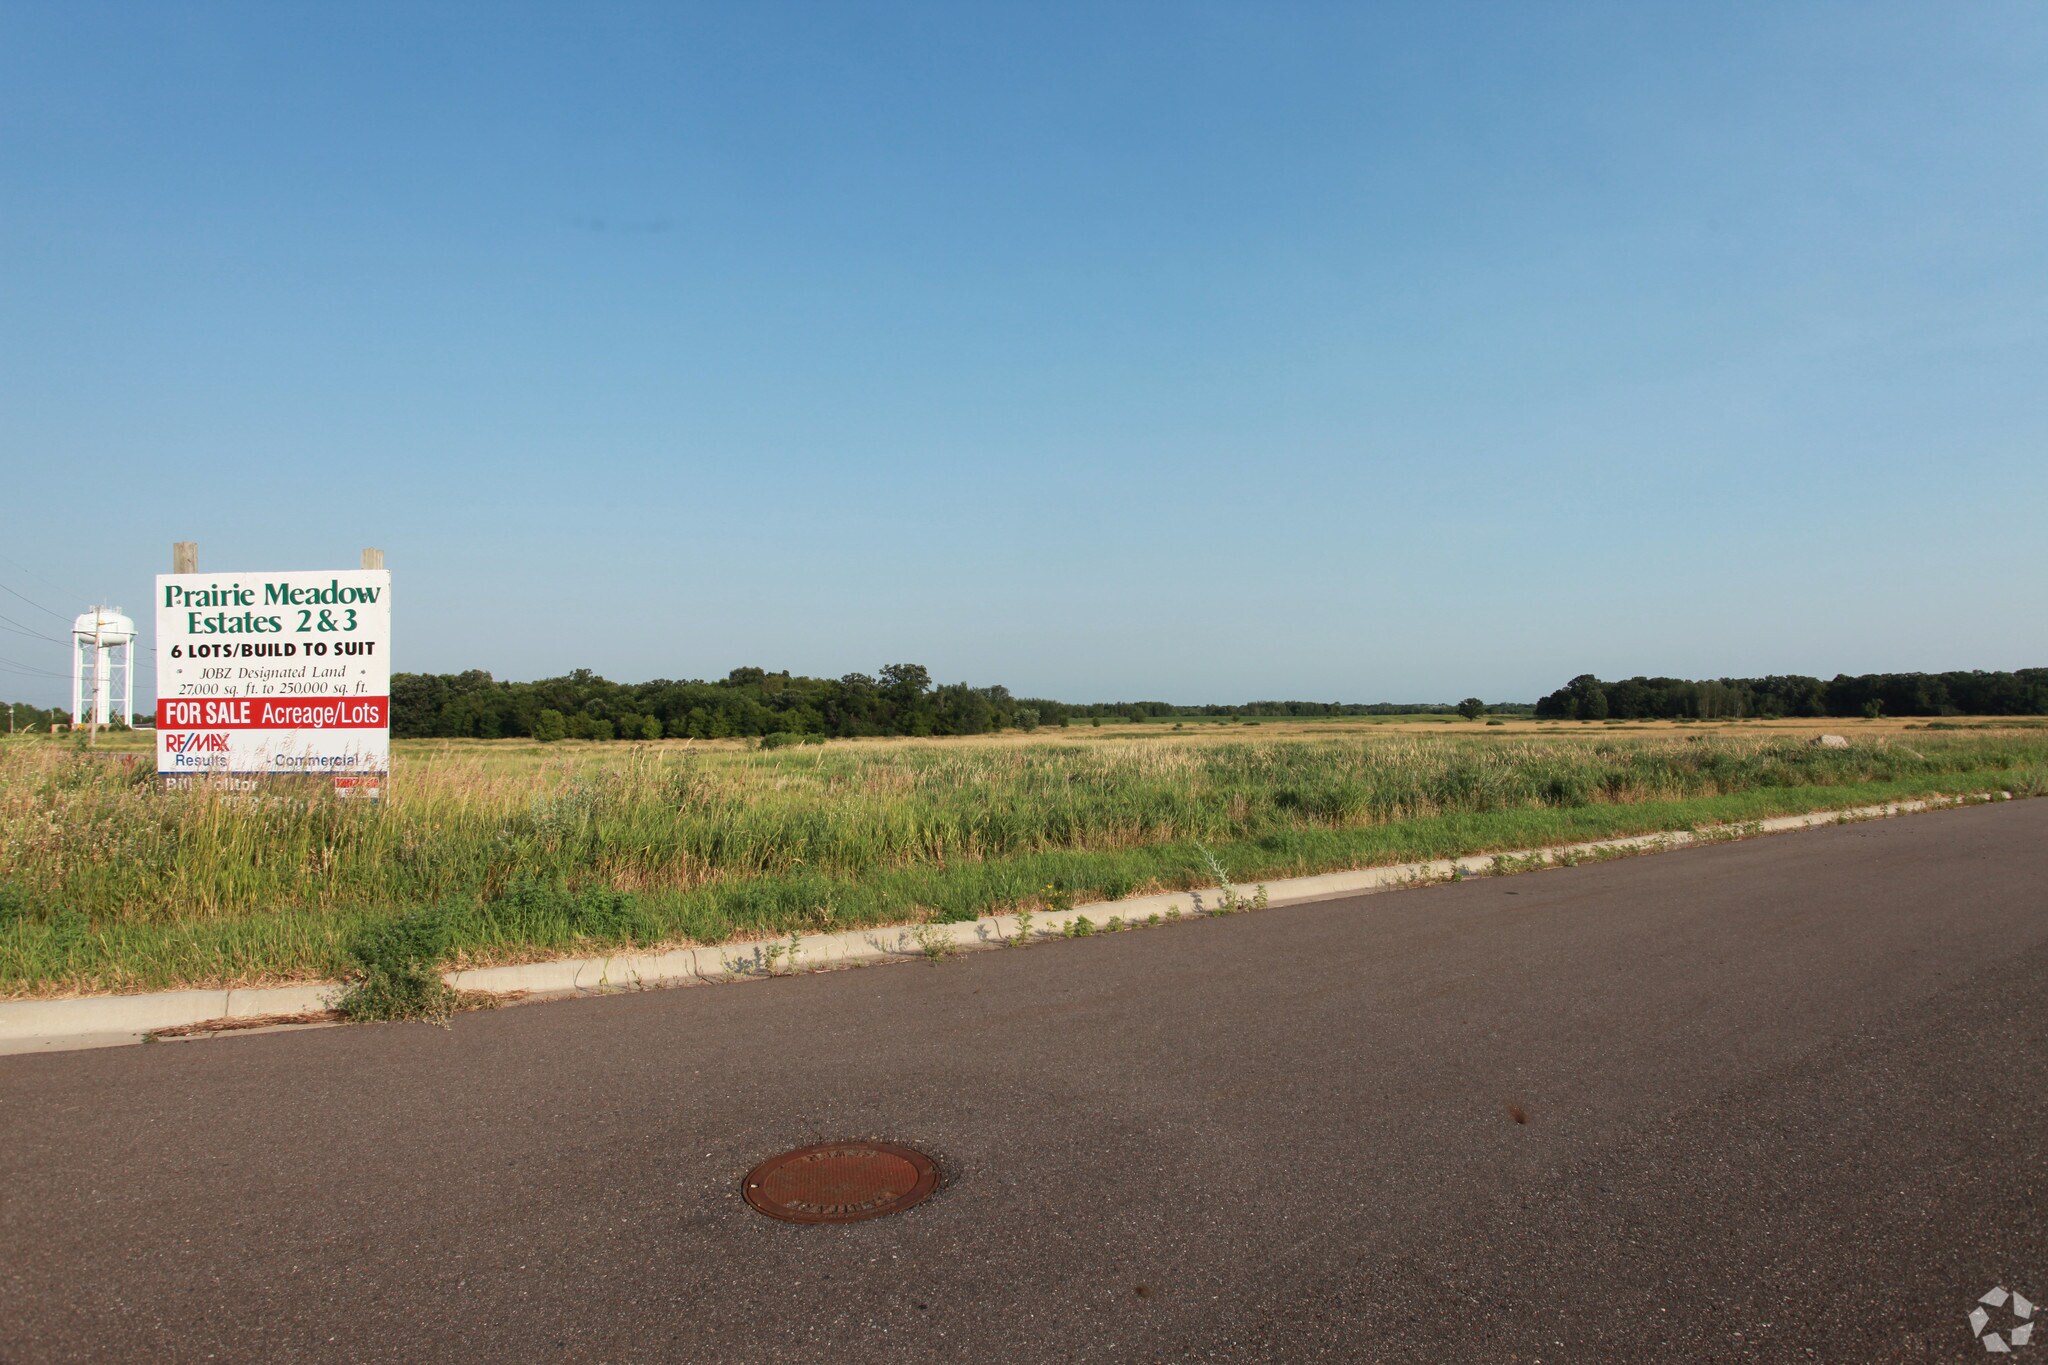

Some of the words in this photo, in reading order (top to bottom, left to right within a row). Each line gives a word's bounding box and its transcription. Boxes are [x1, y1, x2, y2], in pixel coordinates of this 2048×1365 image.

[165, 583, 255, 607] Prairie
[264, 579, 381, 605] Meadow
[188, 611, 282, 634] Estates
[171, 645, 182, 658] 6
[189, 643, 296, 658] LOTS/BUILD
[303, 643, 327, 656] TO
[334, 642, 375, 656] SUIT
[200, 667, 232, 680] JOBZ
[238, 666, 306, 681] Designated
[312, 665, 346, 678] Land
[179, 684, 218, 696] 27,000
[224, 686, 238, 697] sq.
[244, 683, 258, 697] ft.
[262, 685, 274, 695] to
[279, 682, 328, 695] 250,000
[333, 684, 348, 696] sq.
[355, 681, 368, 697] ft.
[166, 702, 202, 724] FOR
[205, 701, 250, 724] SALE
[262, 702, 379, 728] Acreage/Lots
[166, 733, 231, 753] RE/MAX
[176, 754, 227, 767] Results
[275, 753, 359, 767] Commercial
